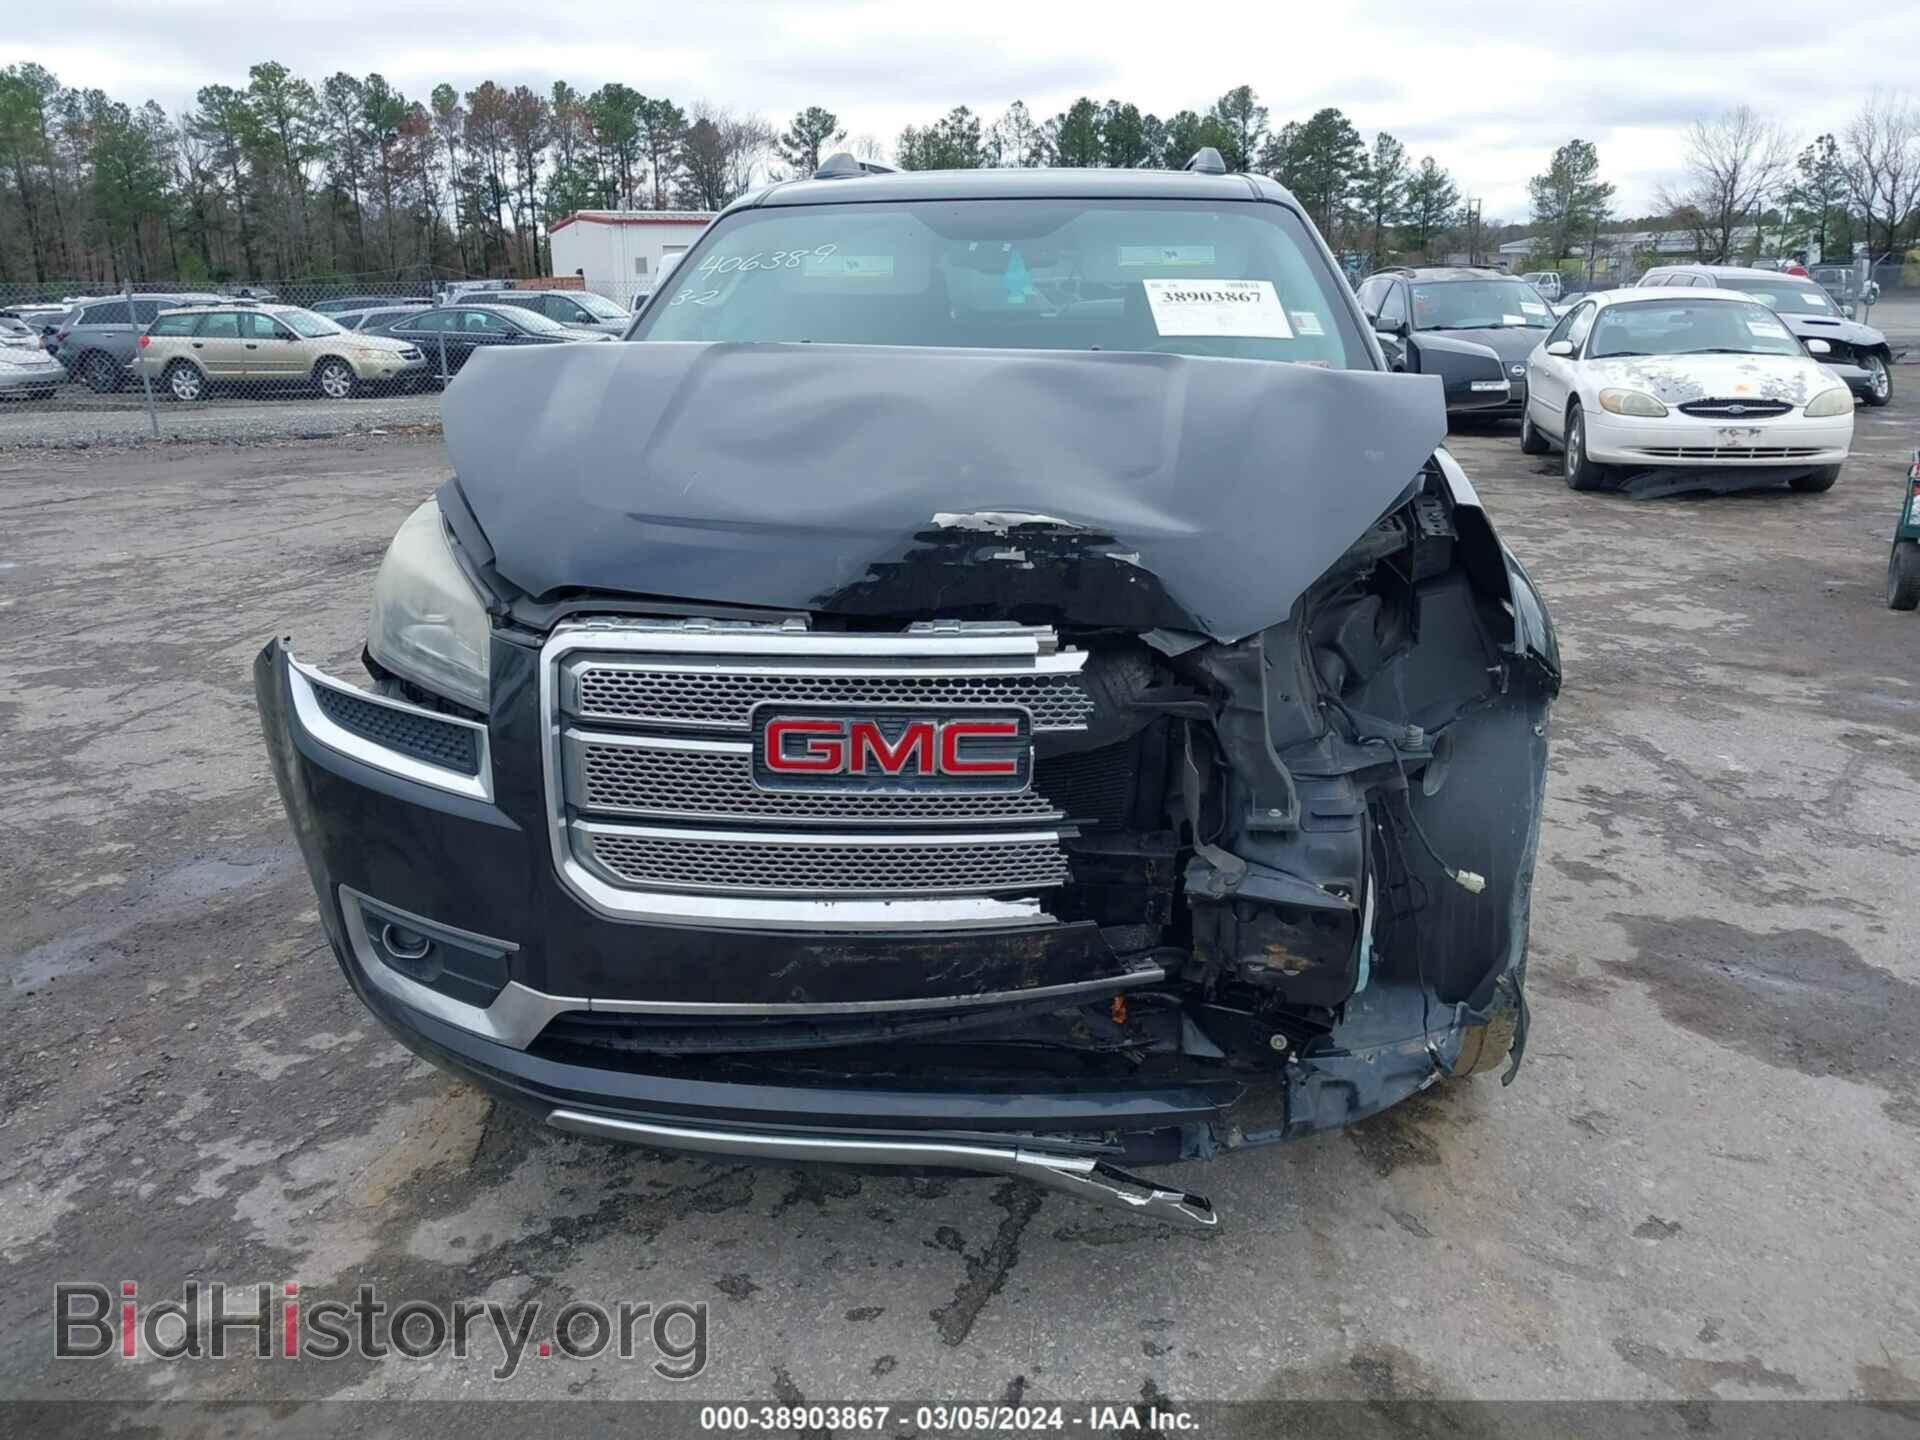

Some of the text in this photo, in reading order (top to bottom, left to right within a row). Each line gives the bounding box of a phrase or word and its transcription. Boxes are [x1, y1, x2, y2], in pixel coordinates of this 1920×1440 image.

[698, 243, 838, 280] 406389
[1162, 291, 1261, 303] 38903867
[764, 716, 1019, 776] GMC
